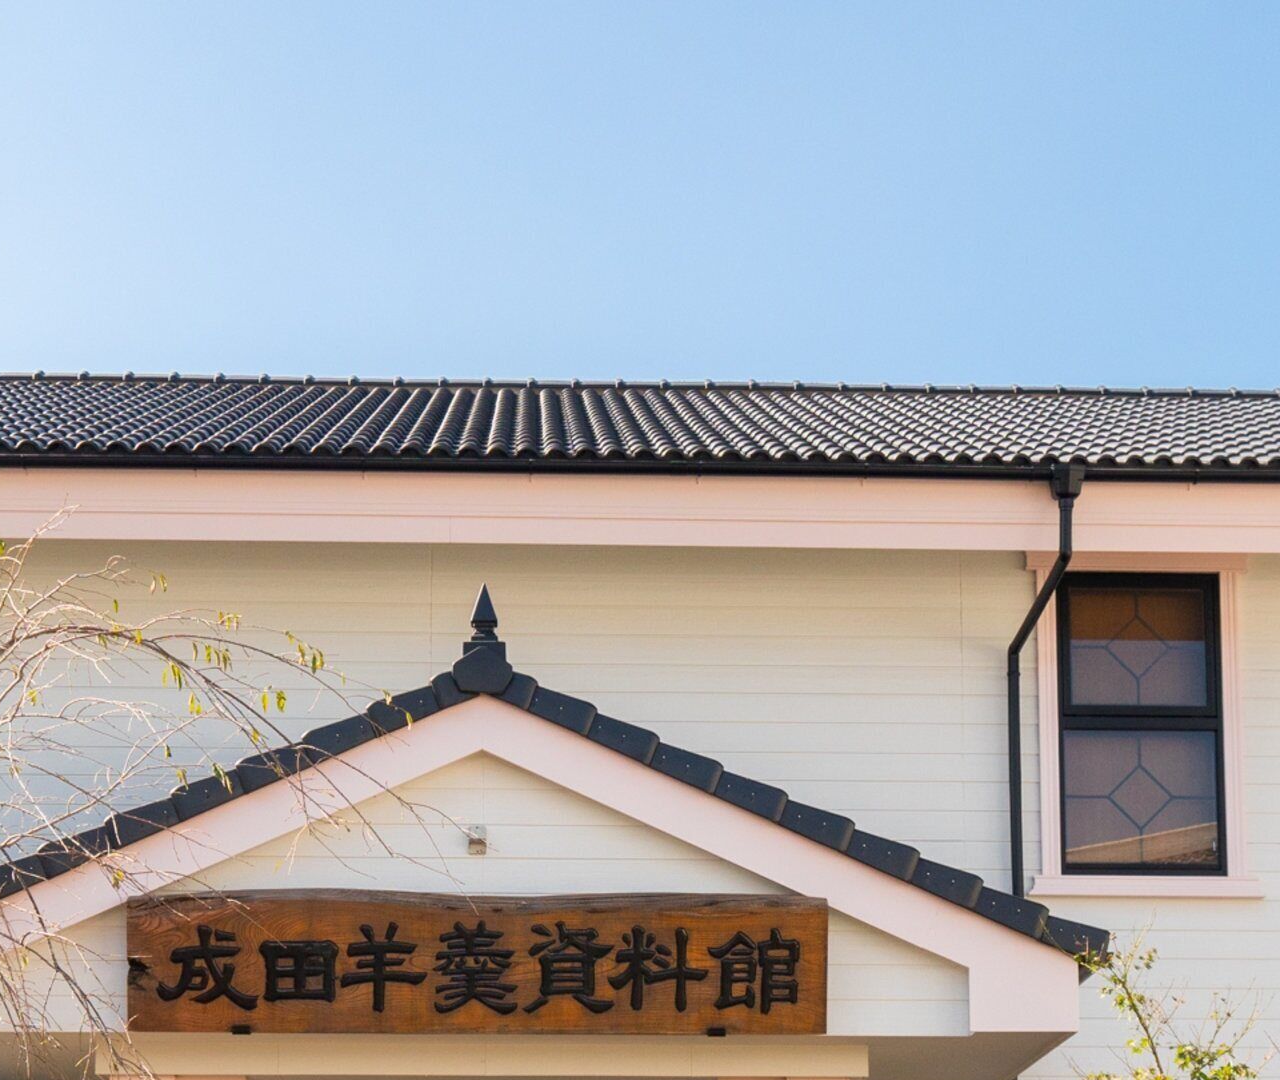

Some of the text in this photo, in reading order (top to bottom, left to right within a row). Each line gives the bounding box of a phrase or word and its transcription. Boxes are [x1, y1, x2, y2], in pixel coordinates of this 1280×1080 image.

[156, 920, 800, 1015] 成田羊羹資料館
